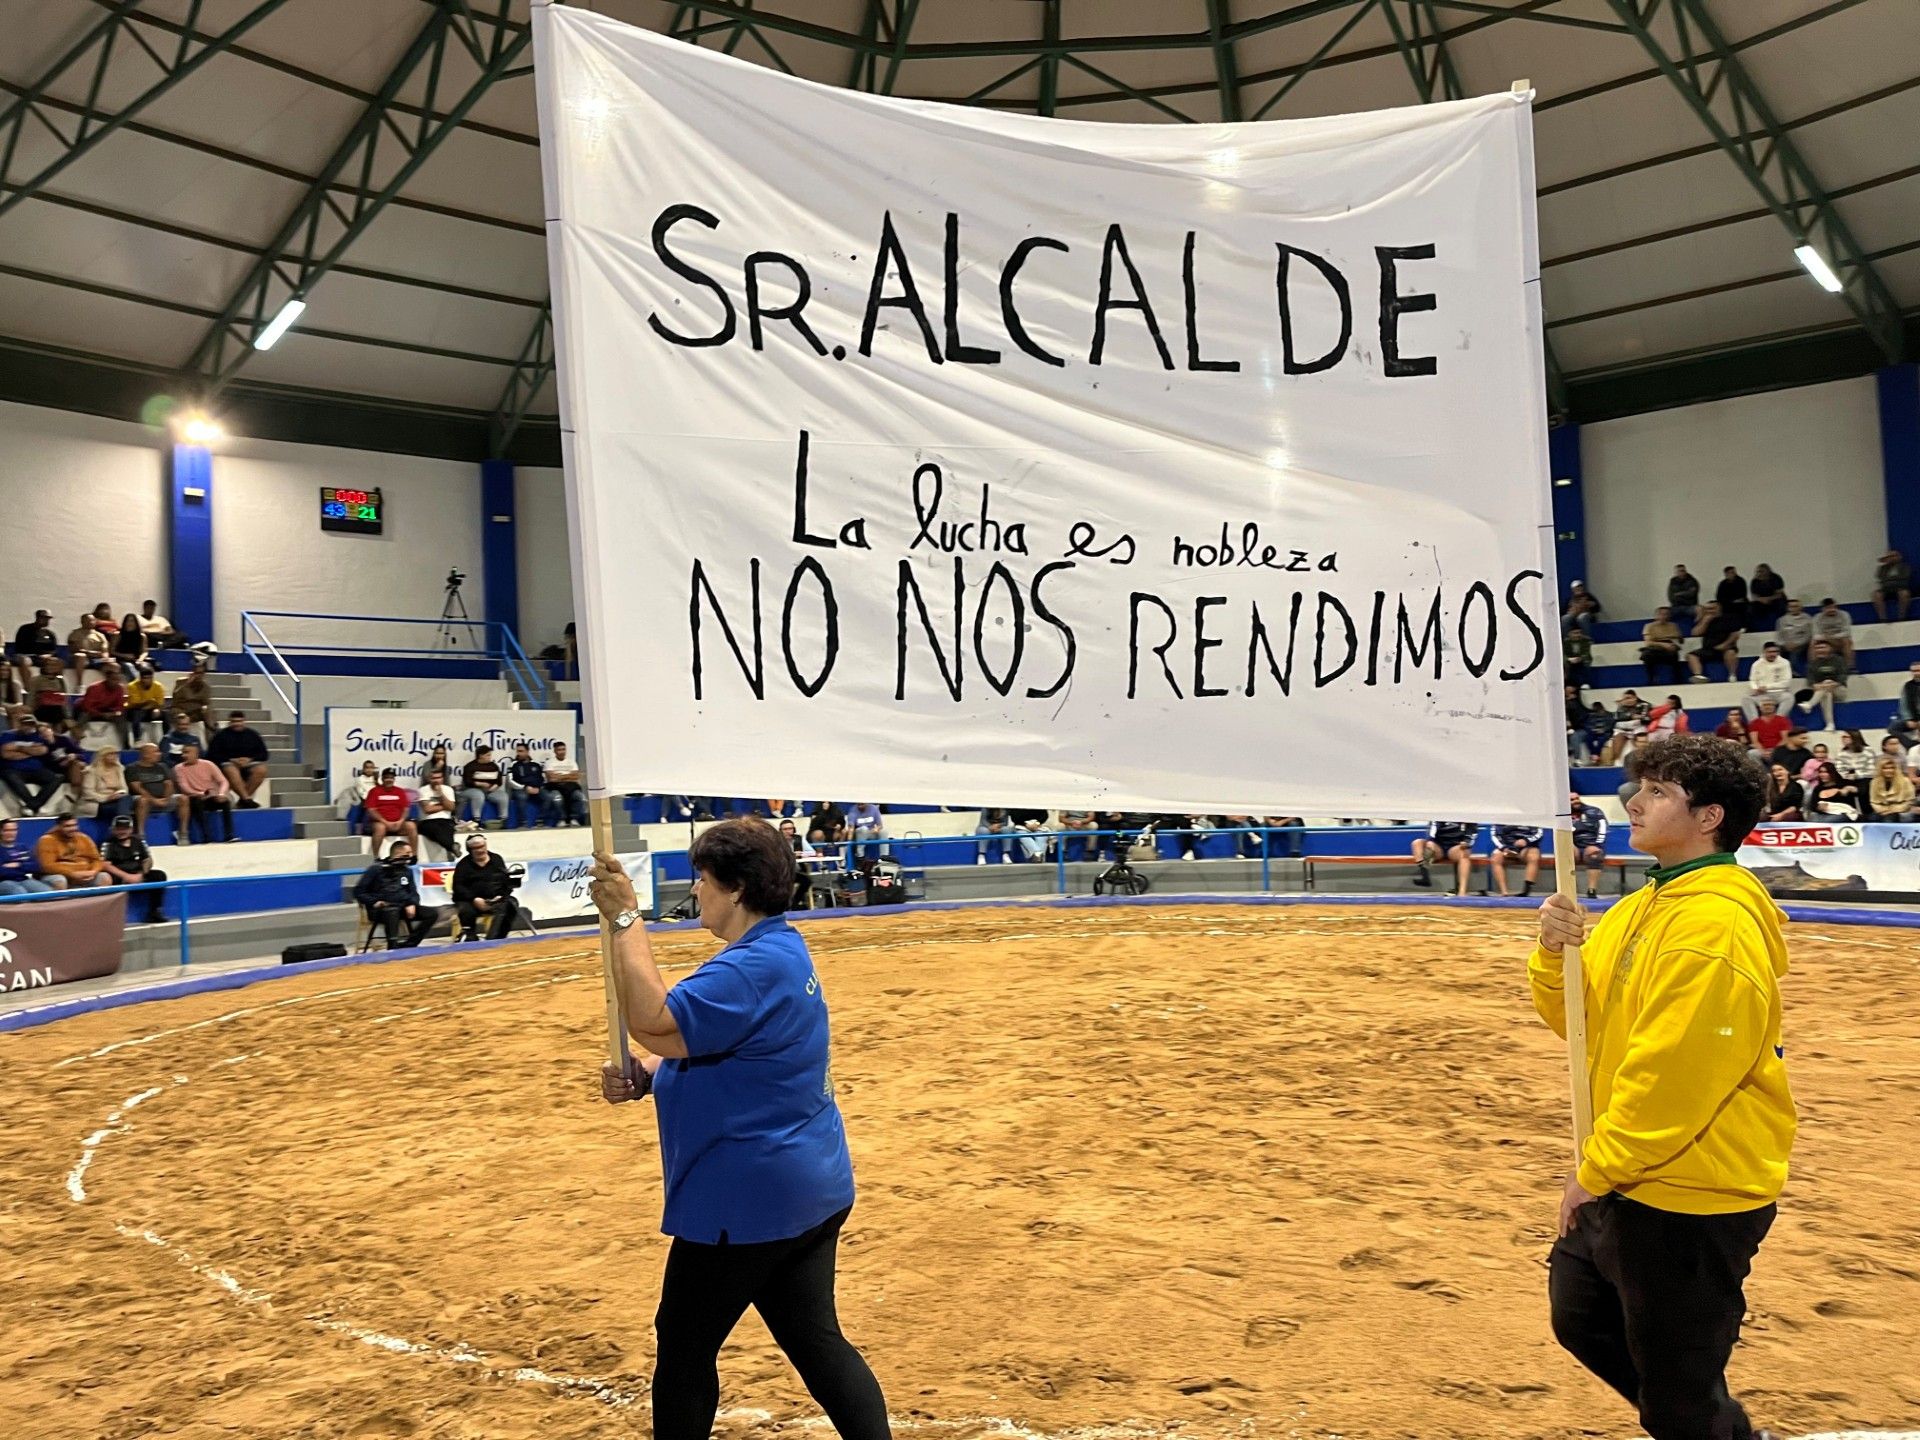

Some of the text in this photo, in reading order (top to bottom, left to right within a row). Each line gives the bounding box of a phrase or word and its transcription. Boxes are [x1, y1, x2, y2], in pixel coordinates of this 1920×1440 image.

[859, 211, 1437, 377] ALCALDE
[793, 430, 1337, 572] La lucha es nobleza
[690, 556, 1543, 702] NO NOS RENDIMOS
[345, 728, 405, 752] Santa
[408, 730, 453, 756] Lucía
[463, 732, 482, 752] de
[1761, 830, 1833, 845] SPAR
